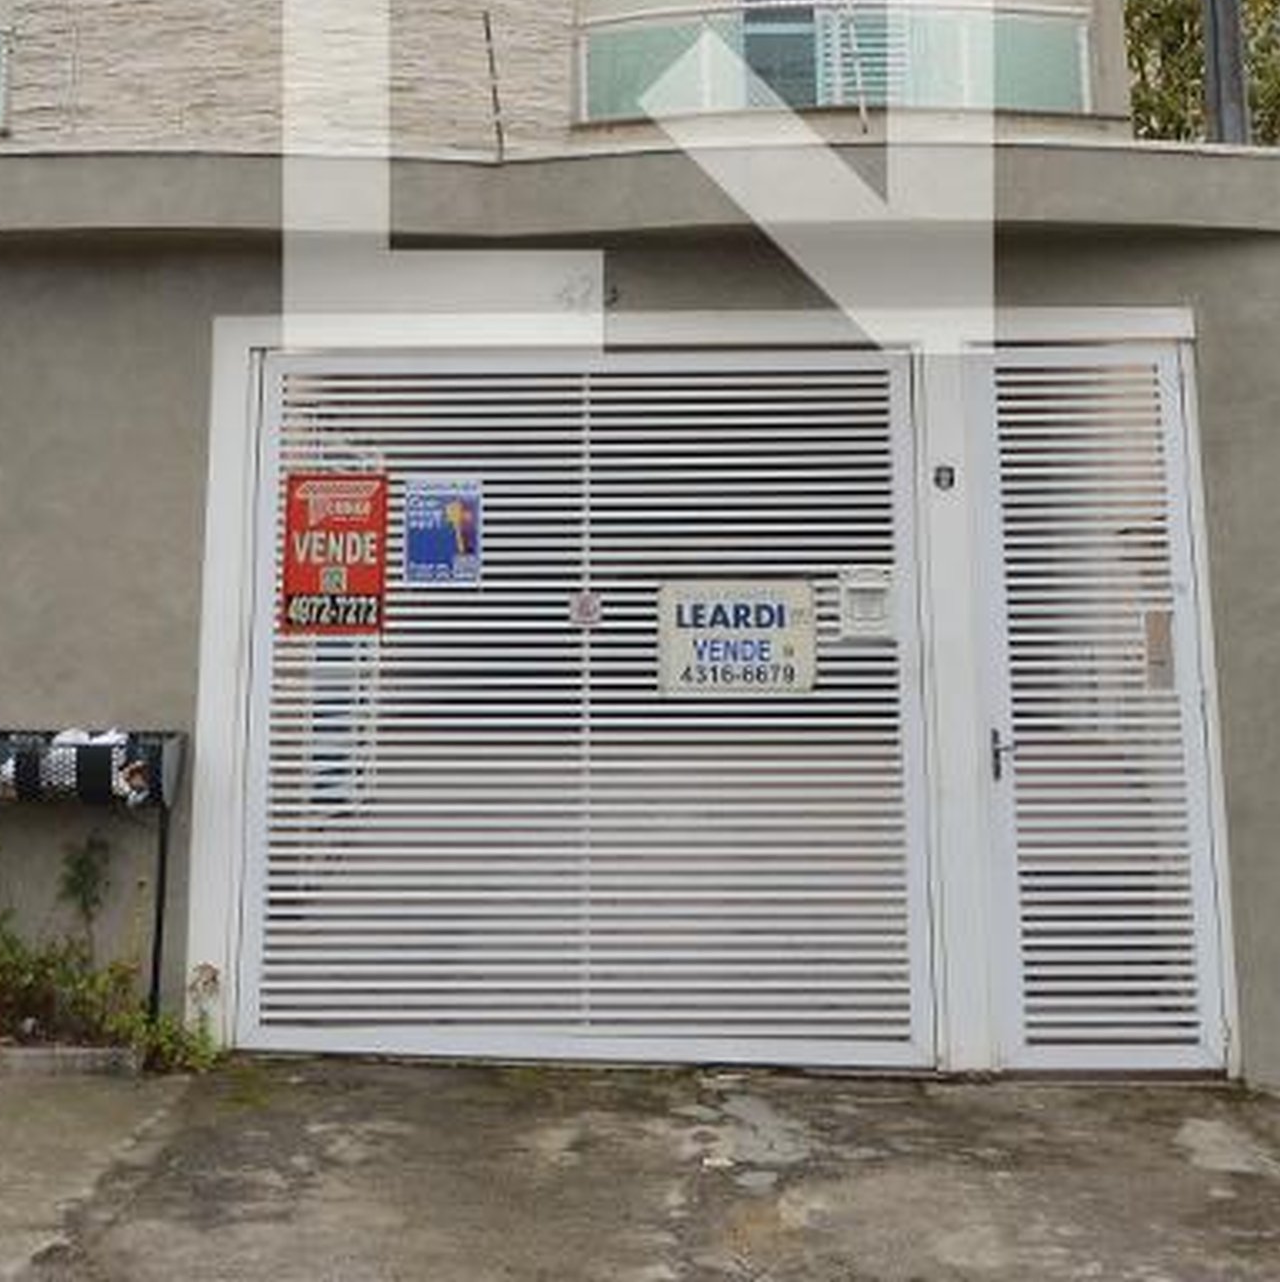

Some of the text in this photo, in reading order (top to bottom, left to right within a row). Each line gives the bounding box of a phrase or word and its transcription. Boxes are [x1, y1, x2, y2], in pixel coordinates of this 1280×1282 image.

[293, 531, 377, 565] VENDE
[676, 603, 785, 629] LEARDI
[692, 639, 771, 661] VENDE
